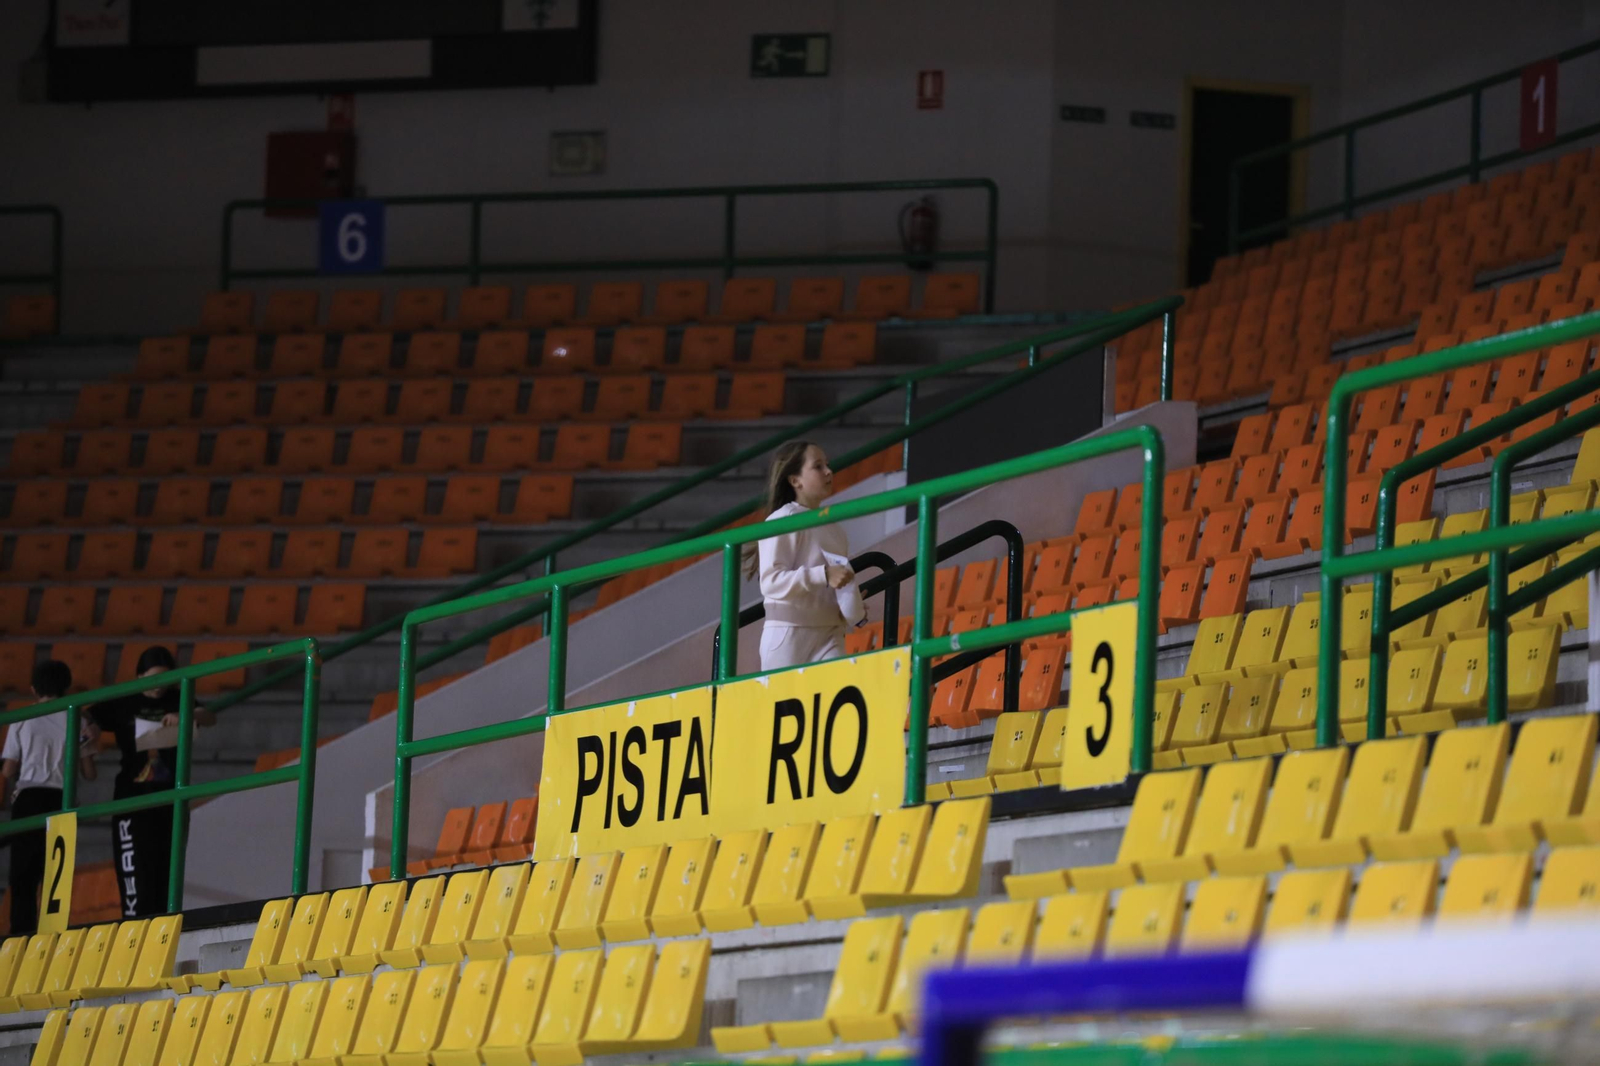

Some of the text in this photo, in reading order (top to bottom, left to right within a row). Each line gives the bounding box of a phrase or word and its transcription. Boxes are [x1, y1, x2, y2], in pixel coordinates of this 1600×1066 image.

[1532, 75, 1546, 133] 1
[337, 212, 367, 262] 6
[1086, 641, 1114, 757] 3
[570, 685, 868, 833] PISTA RIO
[47, 836, 65, 914] 2
